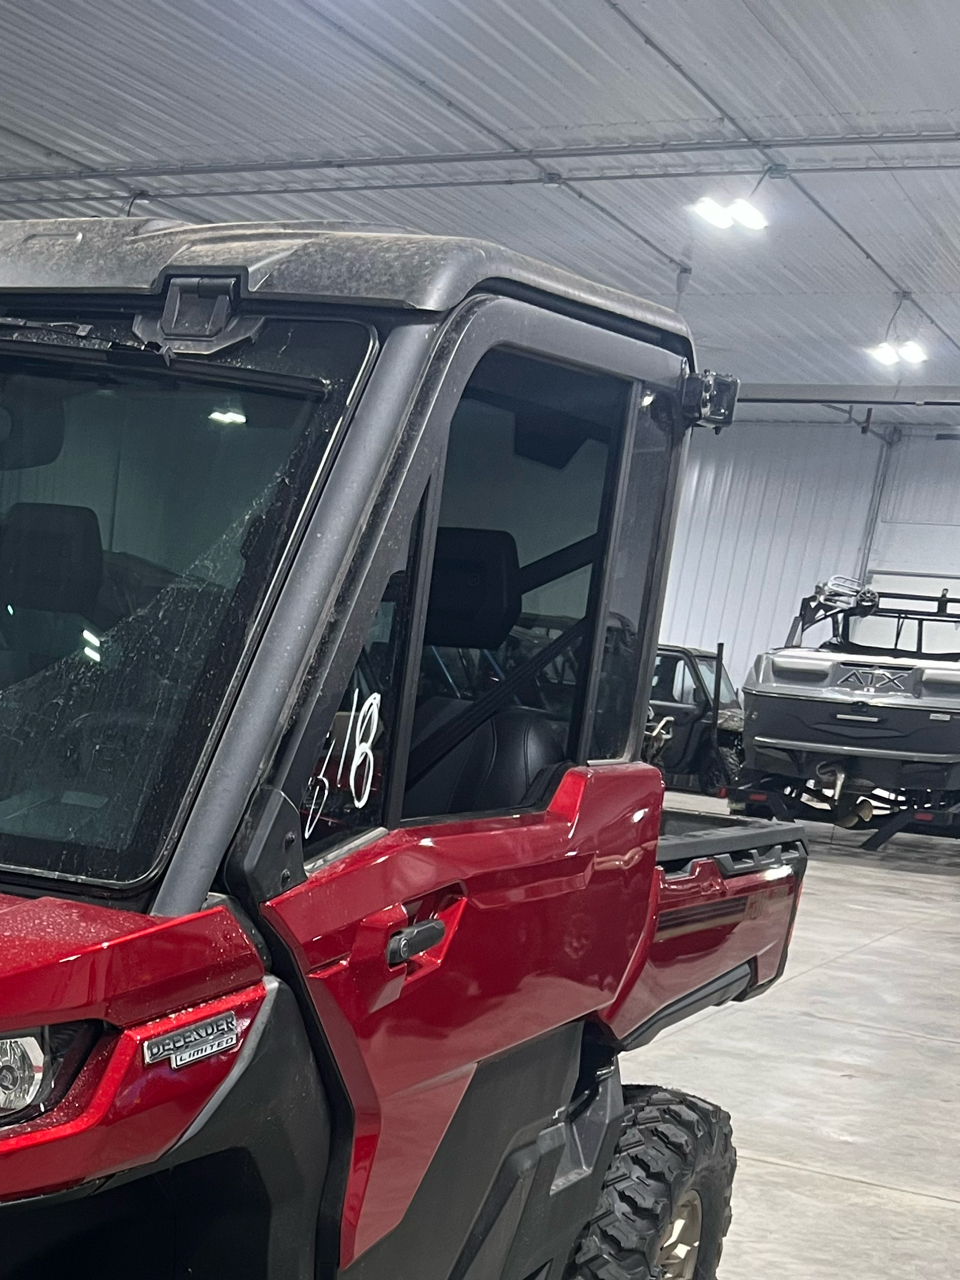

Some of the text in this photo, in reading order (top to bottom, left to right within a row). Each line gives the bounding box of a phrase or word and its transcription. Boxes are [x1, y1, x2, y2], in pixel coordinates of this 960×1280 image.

[837, 669, 909, 690] ATX
[150, 1016, 236, 1056] DEFENDER
[178, 1037, 235, 1062] LIMITED
